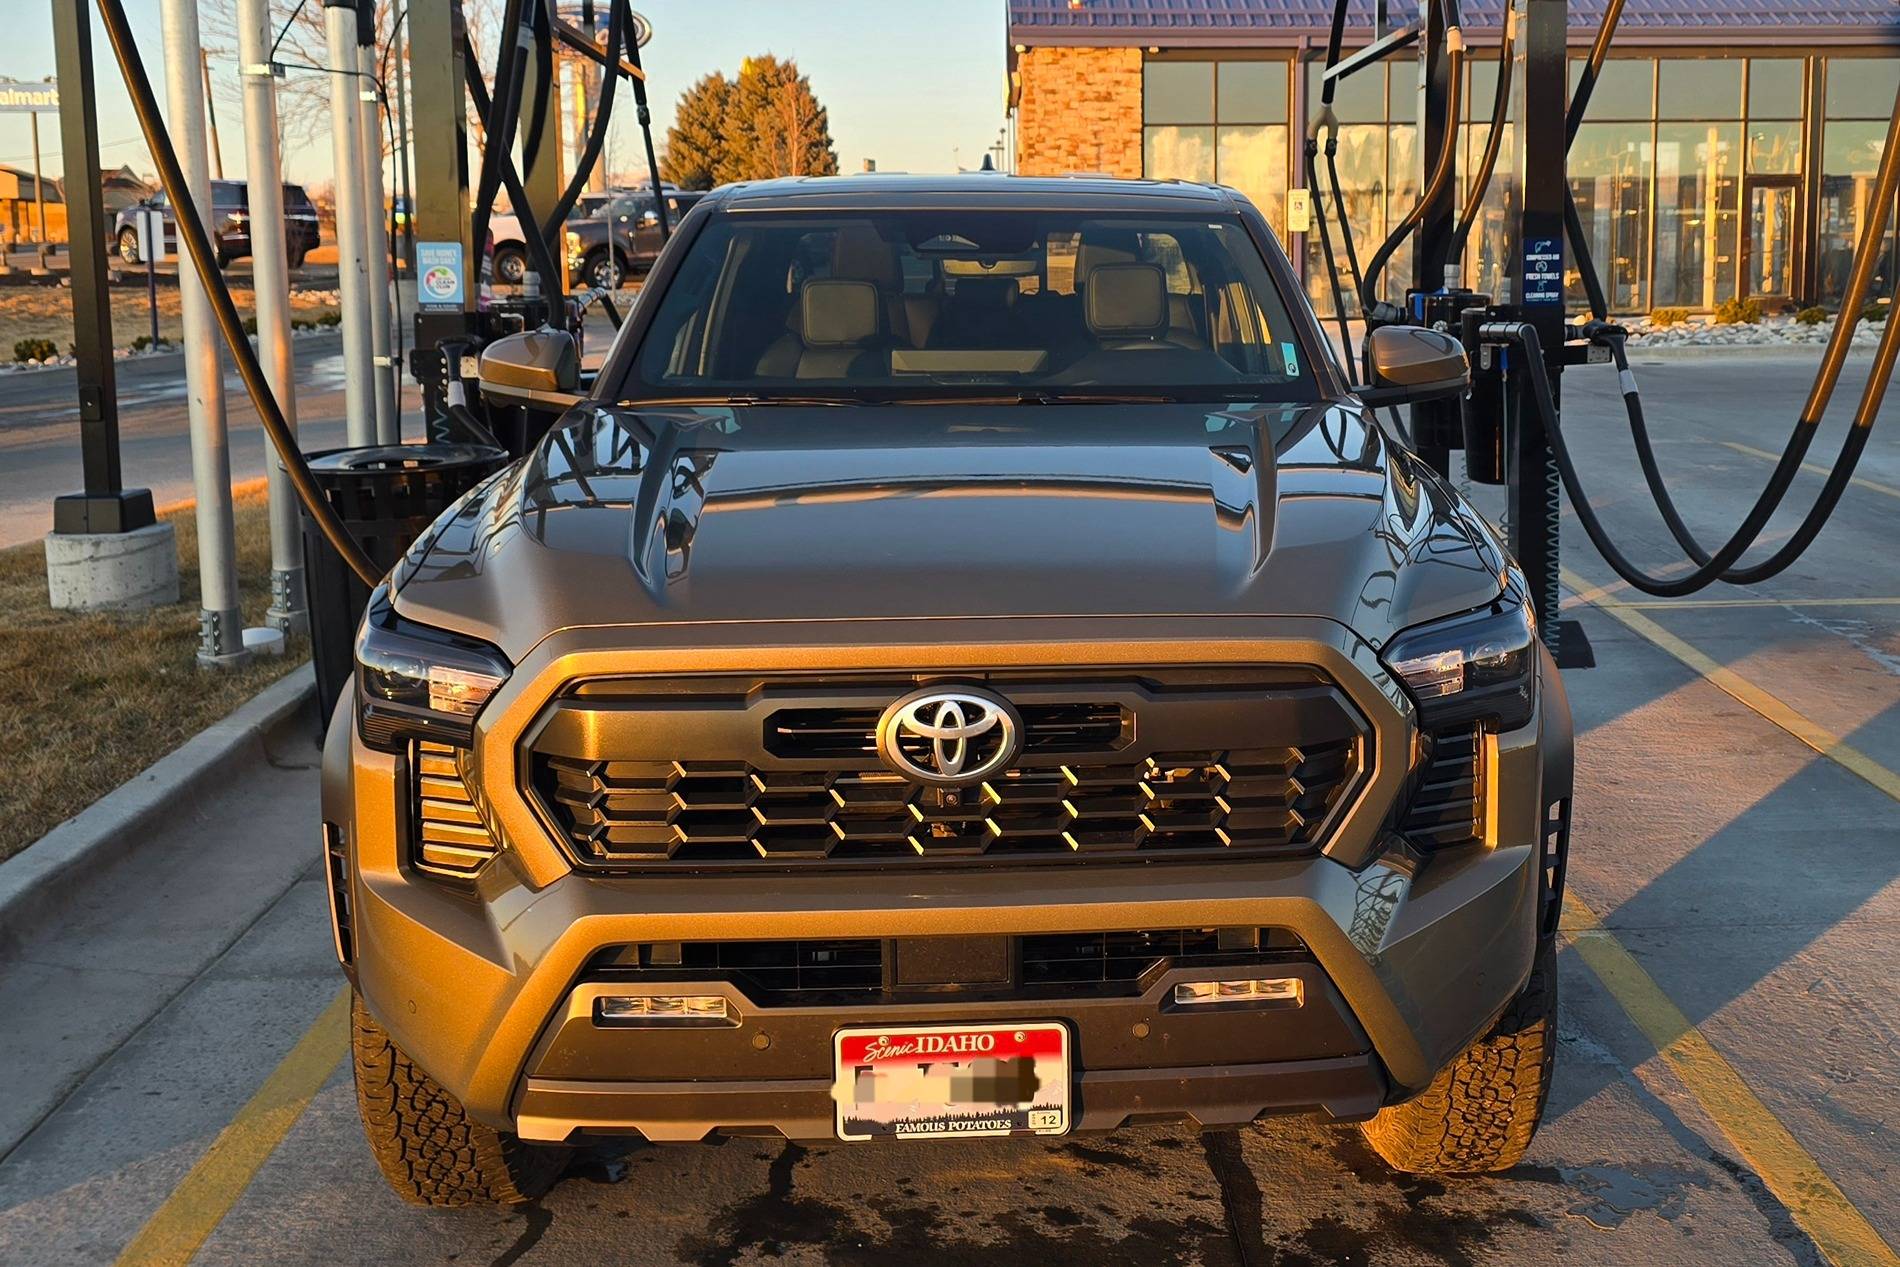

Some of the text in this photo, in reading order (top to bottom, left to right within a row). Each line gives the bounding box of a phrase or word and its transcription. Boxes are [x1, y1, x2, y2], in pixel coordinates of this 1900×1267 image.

[1541, 272, 1560, 280] TOWELS
[863, 1034, 995, 1063] Scenic IDAHO
[1040, 1115, 1057, 1125] 12
[895, 1119, 1012, 1134] FAMOUS POTATOES
